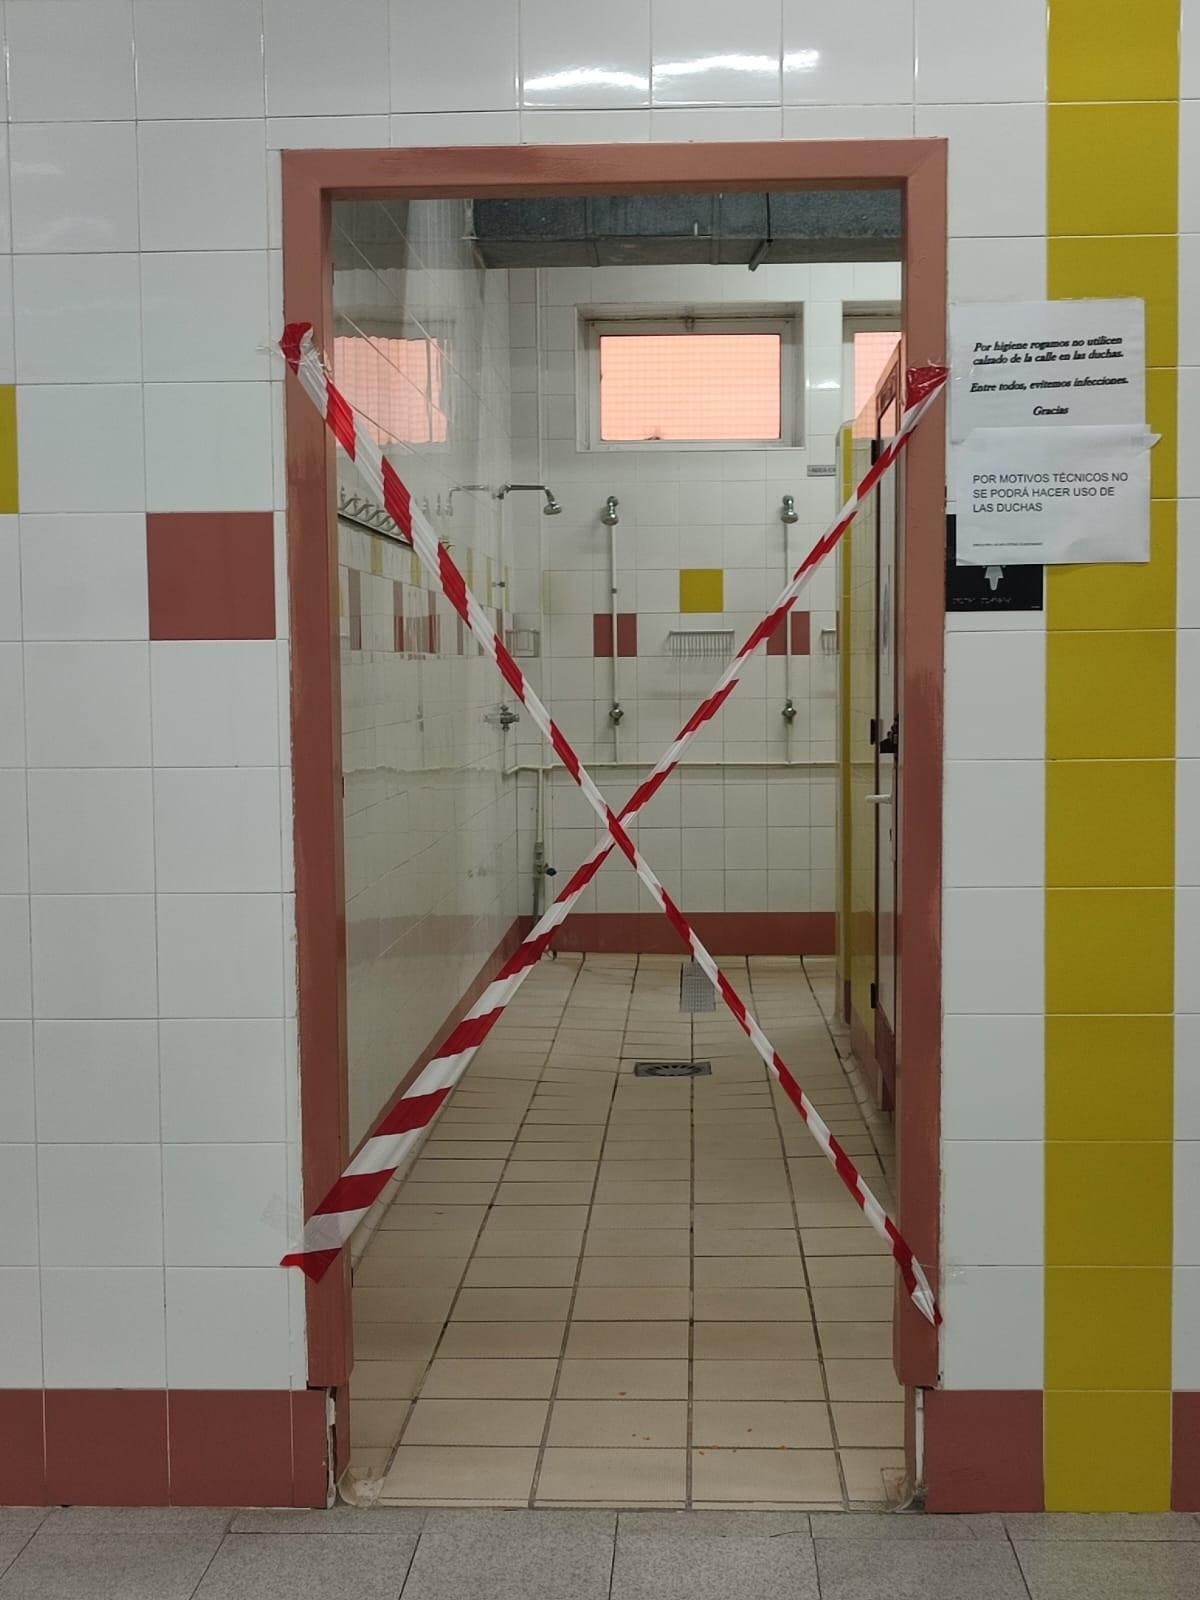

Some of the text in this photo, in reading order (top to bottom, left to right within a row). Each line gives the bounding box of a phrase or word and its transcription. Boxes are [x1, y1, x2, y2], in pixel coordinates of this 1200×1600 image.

[973, 336, 1122, 353] Por higiene rogamos no utilicen
[973, 349, 1124, 366] calzado de la calle en las duchas.
[969, 376, 1129, 393] Entre todos, evitemos infecciones.
[1033, 405, 1069, 416] Gracias
[973, 472, 1128, 484] POR MOTIVOS TÉCNICOS NO
[973, 487, 1115, 499] SE PODRÁ HACER USO DE
[973, 502, 1043, 513] LAS DUCHAS
